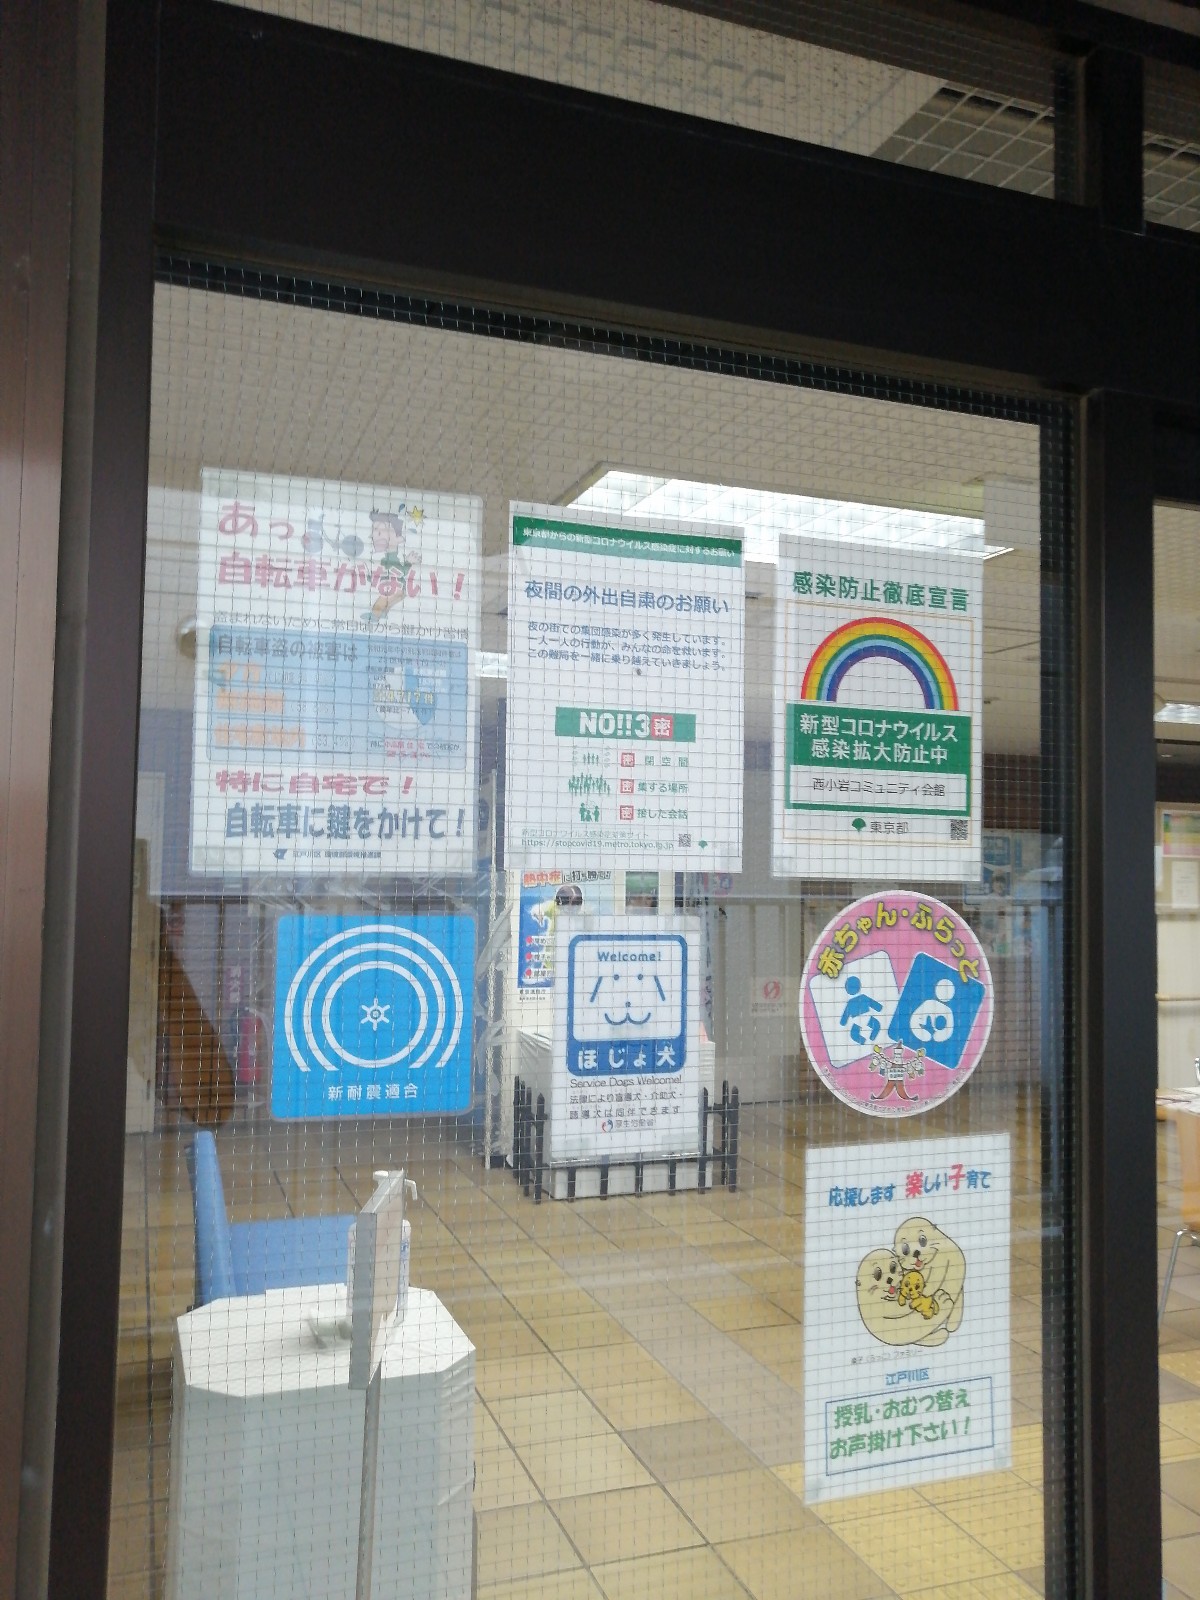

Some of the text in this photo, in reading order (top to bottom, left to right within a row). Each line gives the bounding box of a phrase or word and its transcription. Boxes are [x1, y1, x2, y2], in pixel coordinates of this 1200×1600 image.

[218, 500, 294, 540] あっ
[218, 551, 465, 599] 自転車がない！
[524, 580, 731, 615] 夜間の外出自粛のお願い
[792, 570, 969, 612] 感染防止徹底宣言
[799, 712, 959, 743] 新型コロナウイルス
[810, 737, 949, 765] 感染拡大防止中
[215, 769, 414, 796] 特に自宅で！
[812, 777, 946, 798] 西小岩コミュニティ会館
[225, 802, 465, 840] 自転車に鍵をかけて！
[870, 821, 909, 835] 東京都
[597, 950, 662, 962] Welcome!
[817, 901, 980, 983] 赤ちゃん・ふらっと
[578, 1045, 676, 1070] ほじょ犬
[327, 1083, 419, 1101] 新耐震適合
[570, 1075, 682, 1088] Service Dogs Welcome!
[828, 1163, 992, 1208] 応援します 楽しい子育て
[885, 1367, 930, 1386] 江戸川区
[834, 1388, 971, 1430] 授乳・おむつ替え
[829, 1416, 971, 1460] お声掛け下さい！
